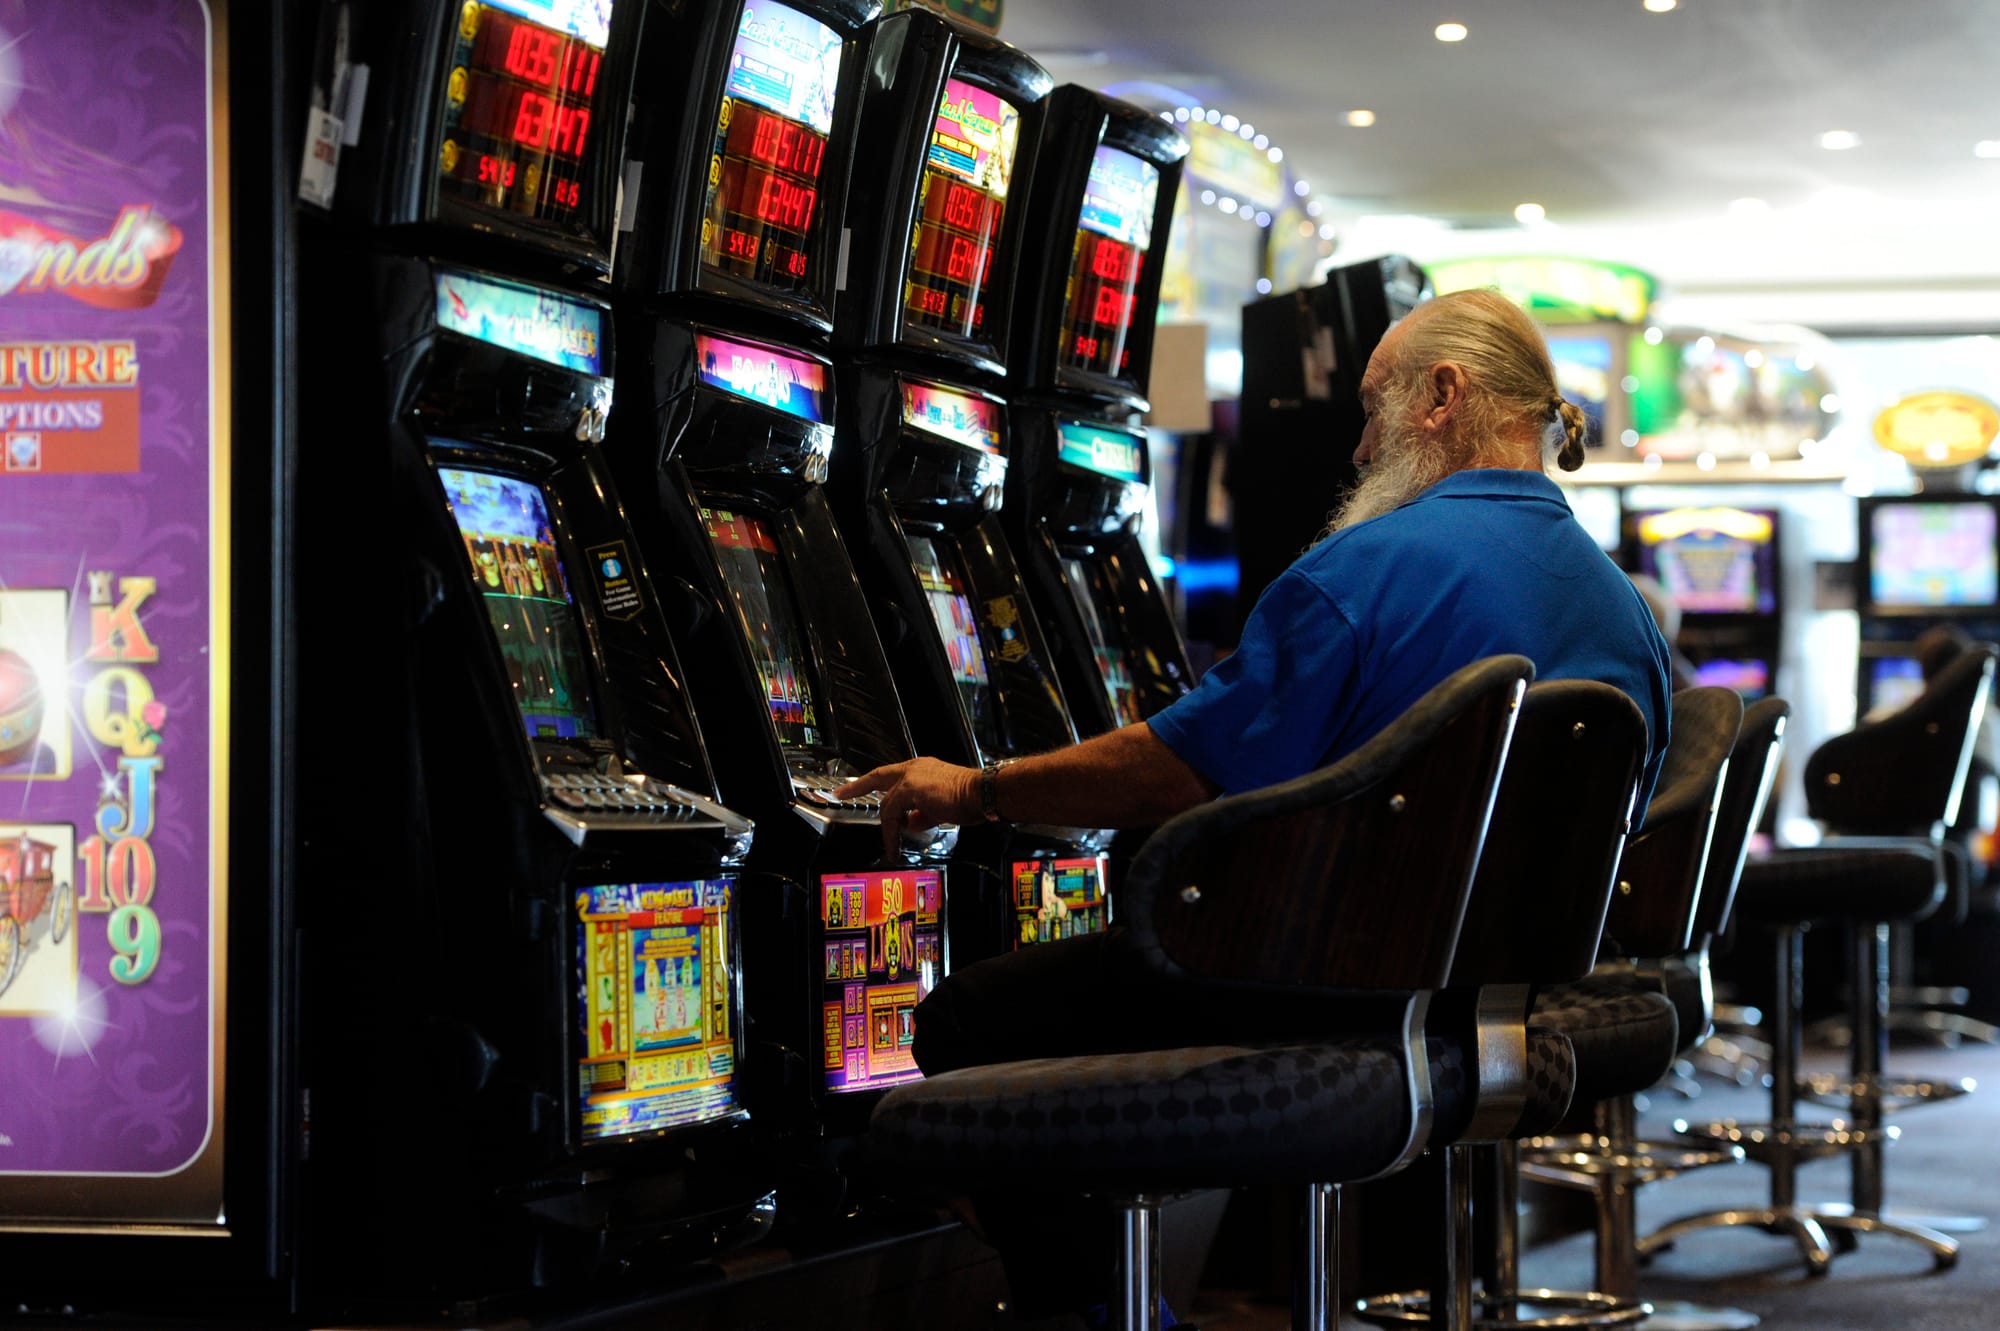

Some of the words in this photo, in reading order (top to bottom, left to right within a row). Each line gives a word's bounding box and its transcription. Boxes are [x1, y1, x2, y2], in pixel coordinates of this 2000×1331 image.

[0, 340, 139, 389] TURE
[91, 576, 159, 663] K
[83, 666, 161, 757] Q
[97, 756, 164, 842] J
[78, 834, 157, 912] 10
[881, 877, 903, 914] 50
[107, 903, 162, 985] 9
